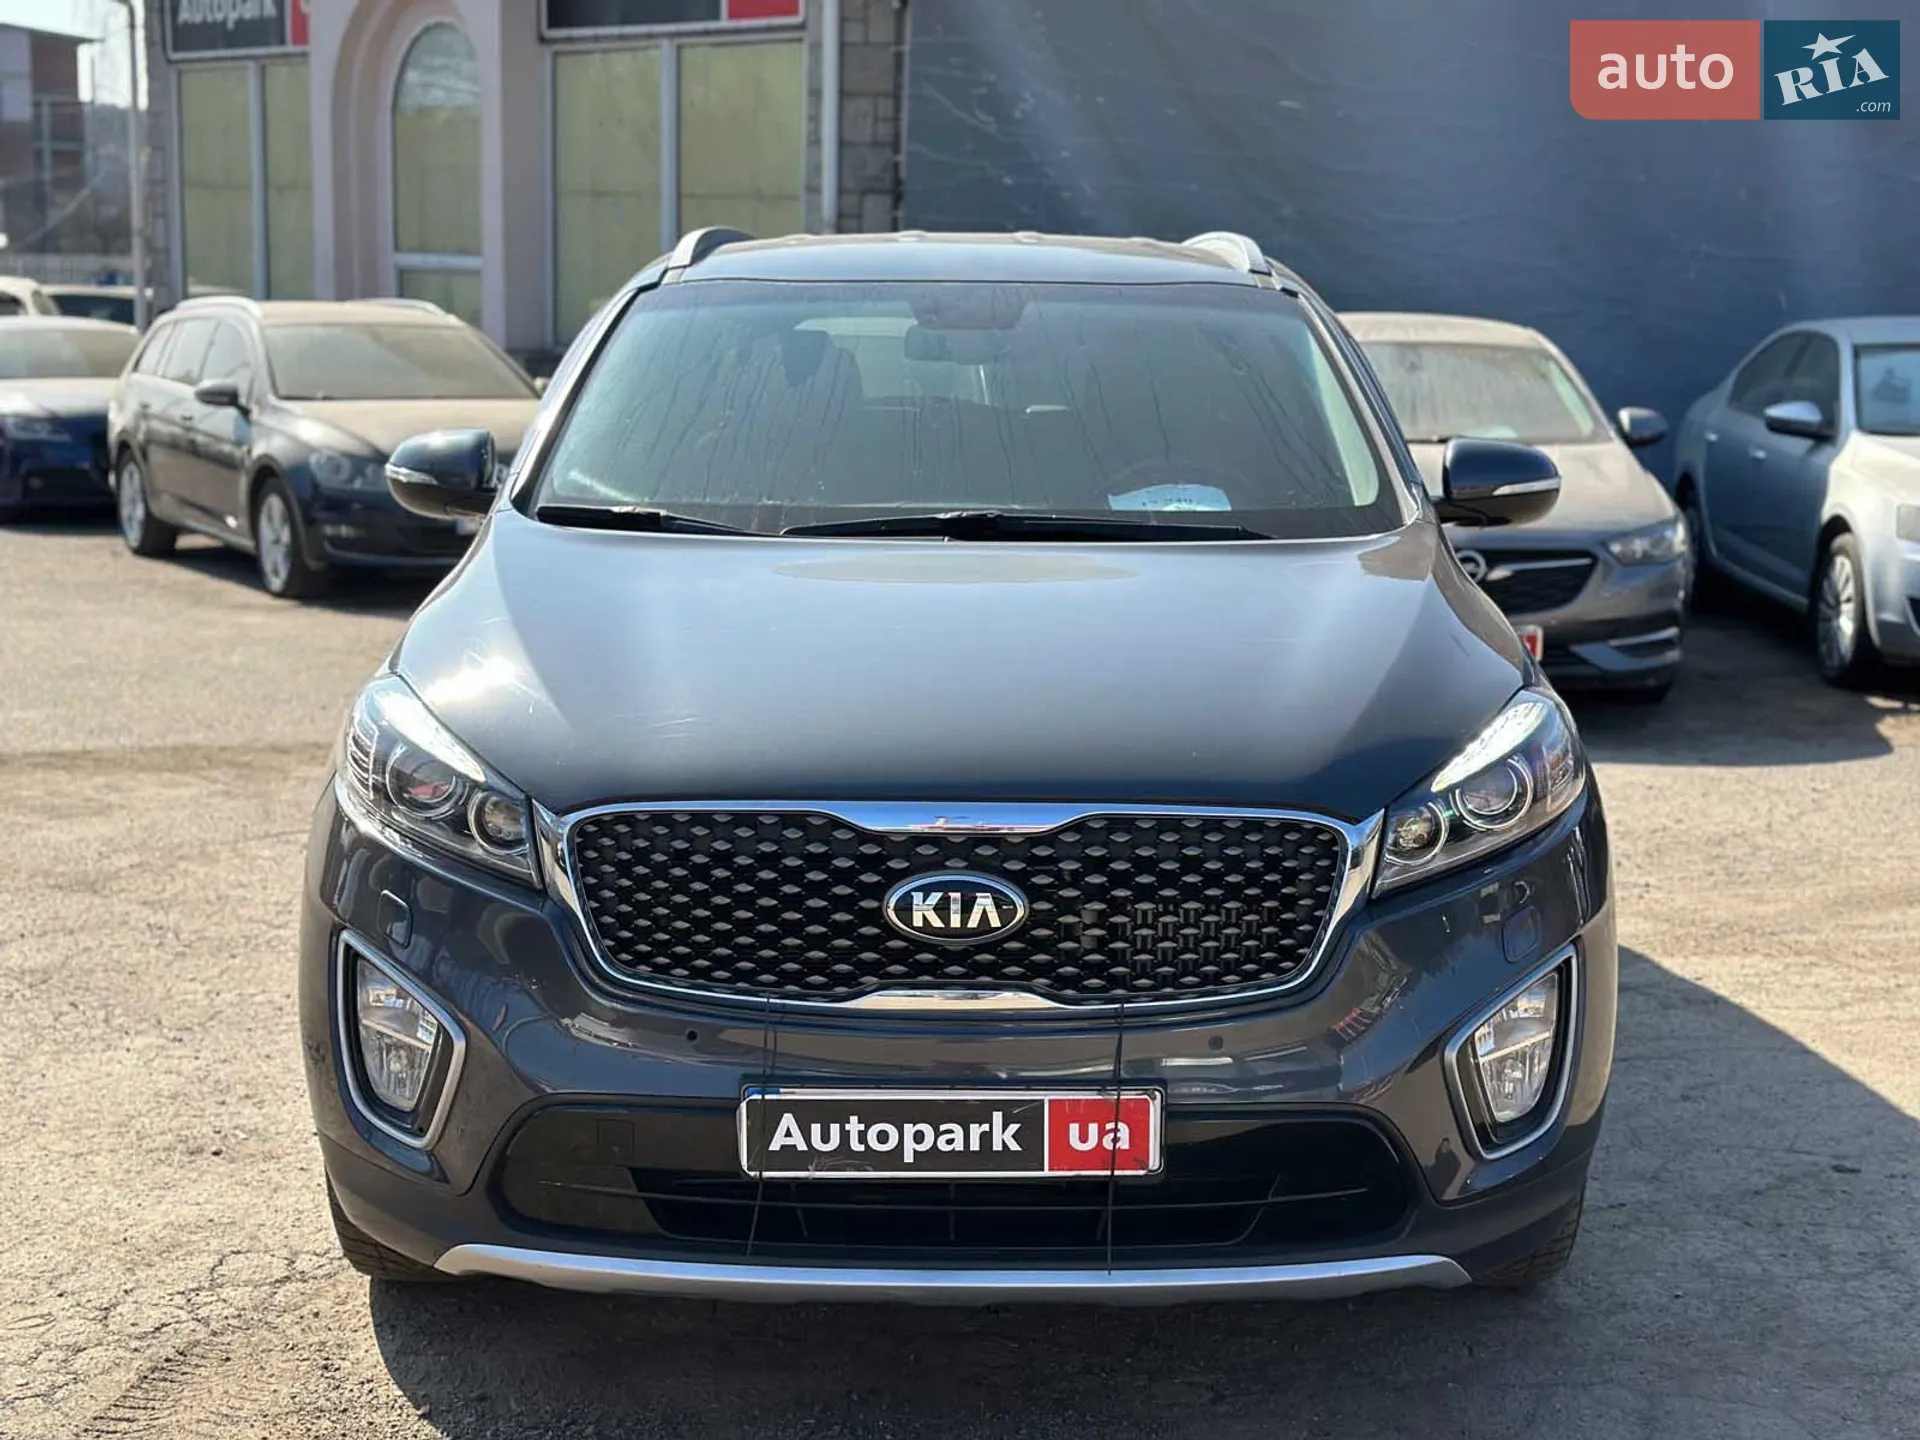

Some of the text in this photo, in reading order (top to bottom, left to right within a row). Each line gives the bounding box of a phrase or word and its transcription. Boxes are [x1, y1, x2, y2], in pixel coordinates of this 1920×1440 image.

[911, 891, 1002, 928] KIA
[768, 1111, 1131, 1163] Autopark ua
